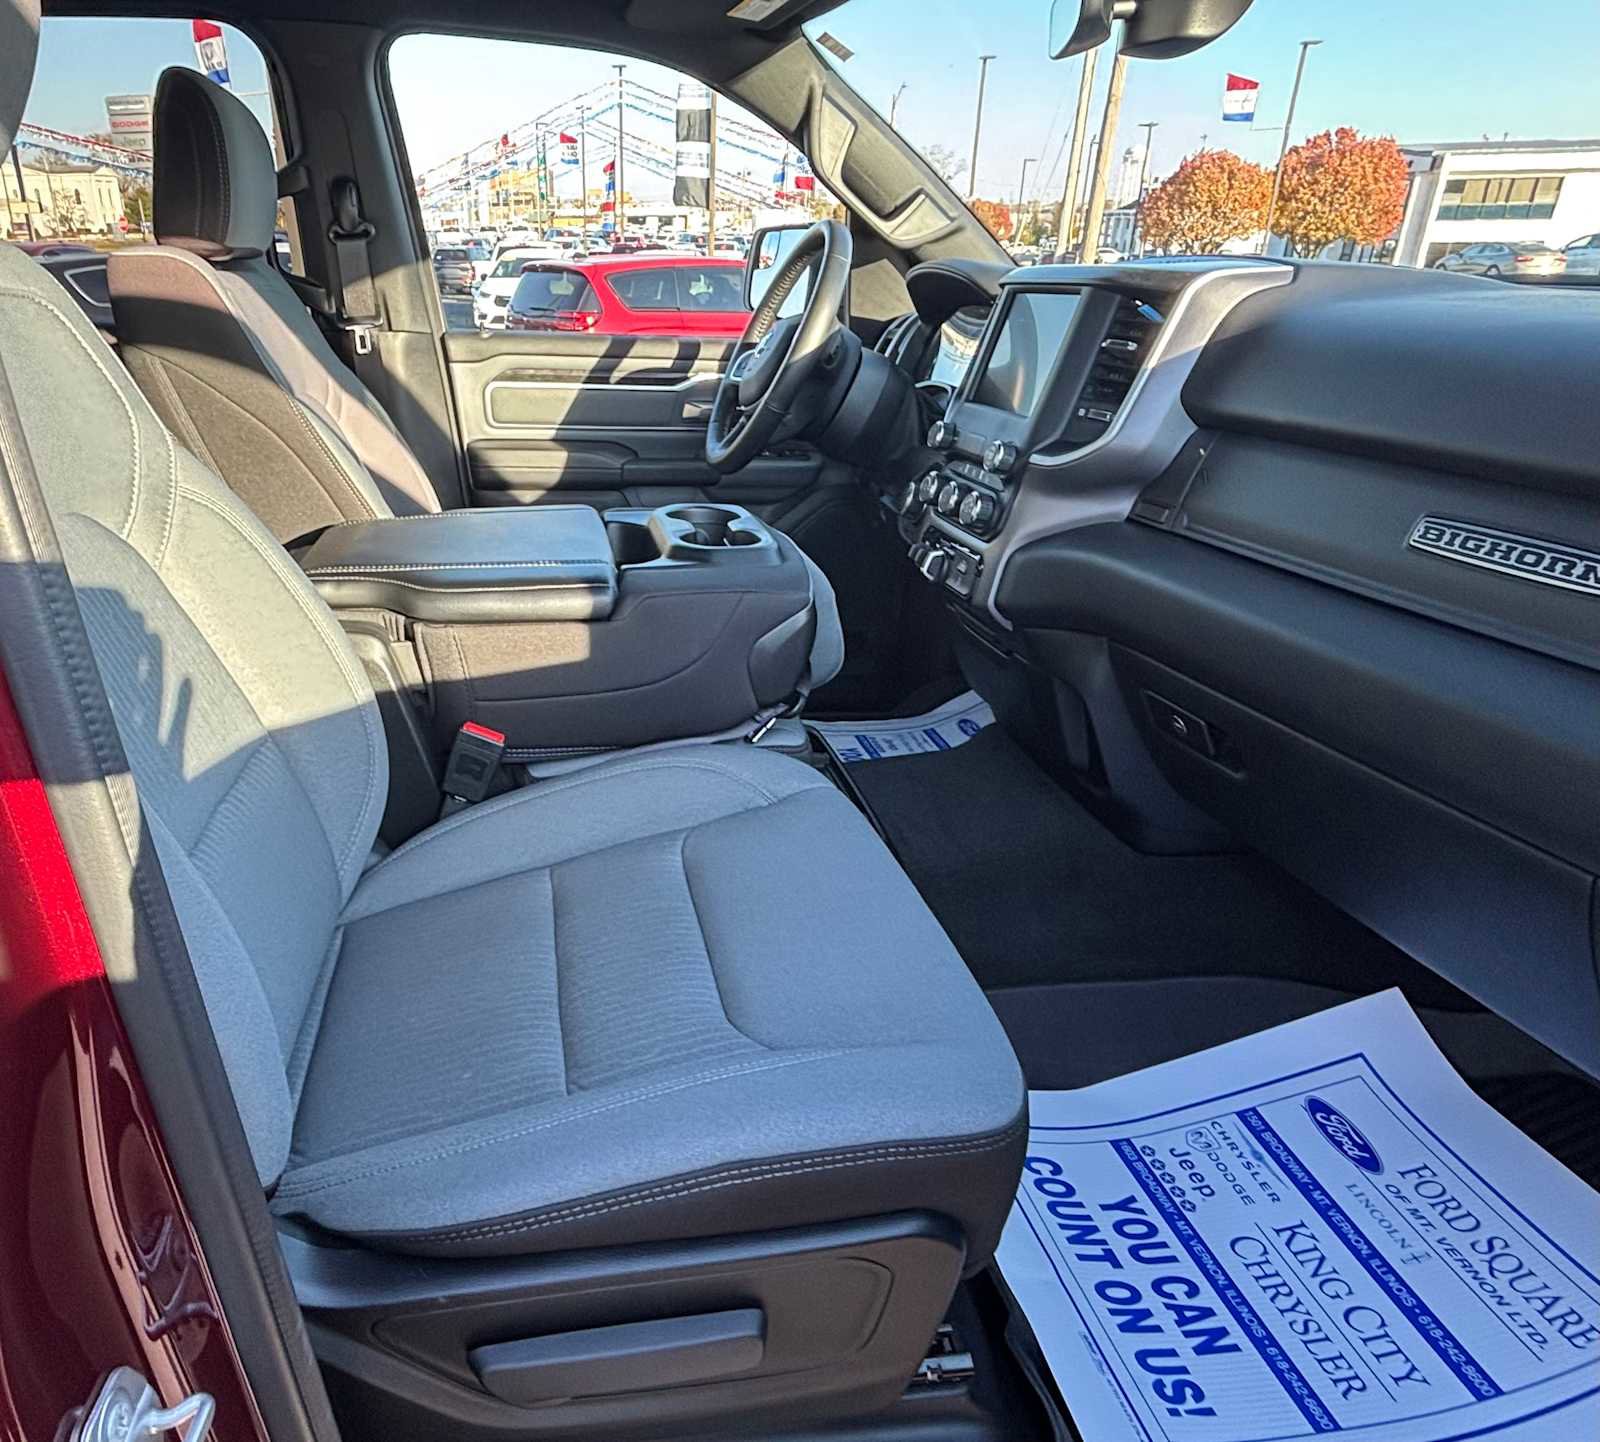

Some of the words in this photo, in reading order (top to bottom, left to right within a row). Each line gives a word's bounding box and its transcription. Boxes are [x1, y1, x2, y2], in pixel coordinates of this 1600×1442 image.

[1169, 1147, 1216, 1198] Jeep
[1207, 1152, 1256, 1206] DODGE
[1211, 1121, 1281, 1203] CHRYSLER
[1315, 1112, 1370, 1159] Ford
[1345, 1184, 1412, 1249] LINCOLN
[1024, 1156, 1124, 1270] COUNT
[1094, 1280, 1164, 1333] ON
[1134, 1348, 1217, 1417] US!
[1098, 1194, 1180, 1265] YOU
[1150, 1276, 1243, 1356] CAN
[1132, 1161, 1178, 1213] BROADWAY
[1225, 1289, 1266, 1337] ILLINOIS
[1261, 1131, 1312, 1184] BROADWAY
[1368, 1258, 1416, 1307] ILLINOIS
[1385, 1184, 1412, 1205] OF
[1406, 1208, 1437, 1232] MT.
[1436, 1237, 1511, 1306] VERNON
[1506, 1312, 1548, 1350] LTD.
[1397, 1163, 1480, 1233] FORD
[1470, 1236, 1600, 1349] SQUARE
[1229, 1236, 1367, 1400] CHRYSLER
[1271, 1219, 1354, 1300] KING
[1343, 1305, 1431, 1387] CITY
